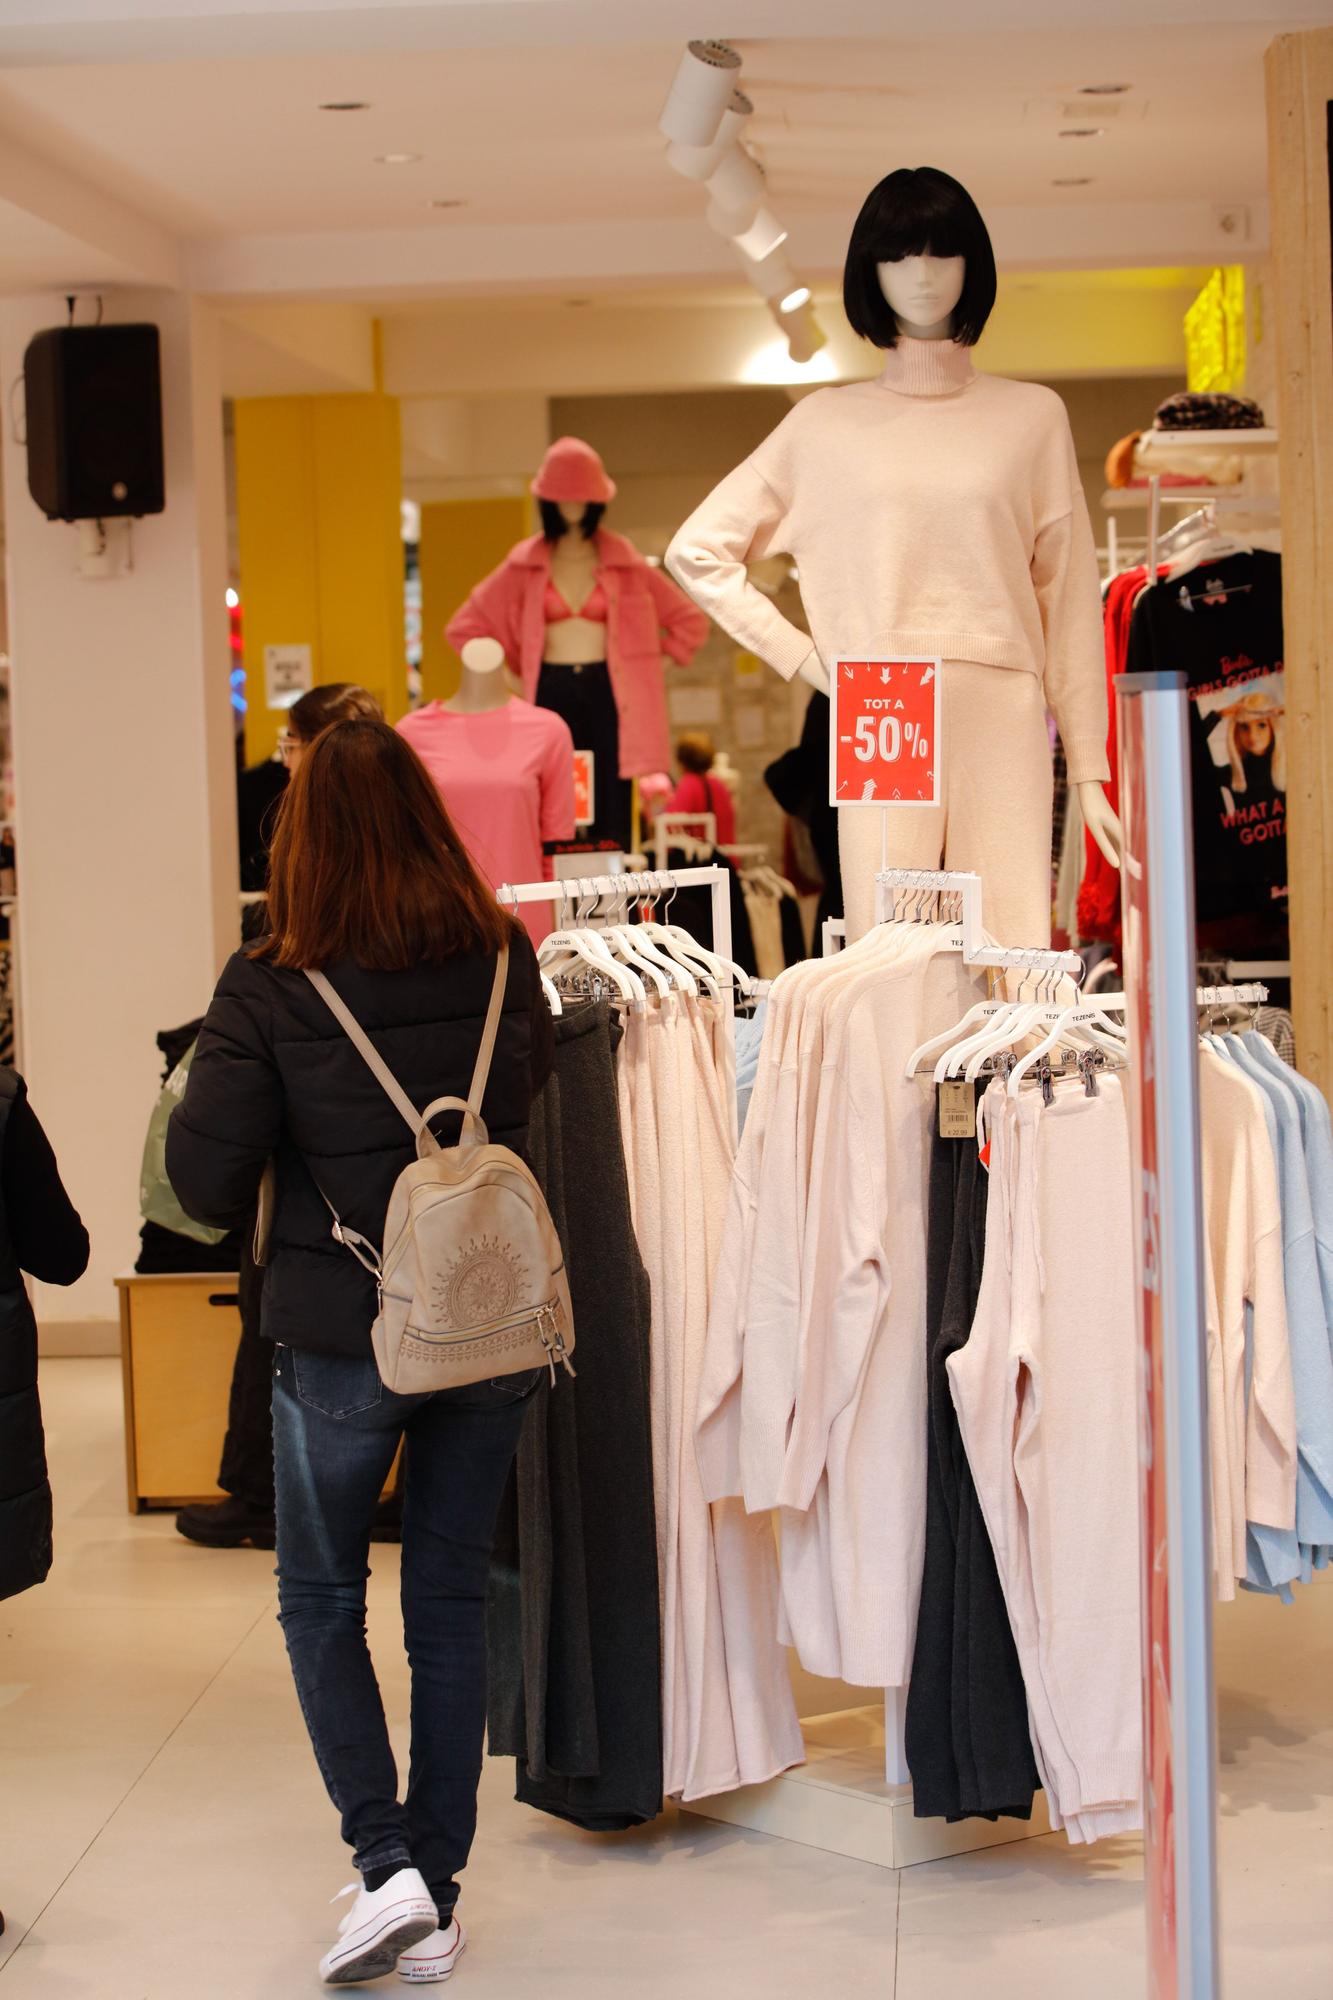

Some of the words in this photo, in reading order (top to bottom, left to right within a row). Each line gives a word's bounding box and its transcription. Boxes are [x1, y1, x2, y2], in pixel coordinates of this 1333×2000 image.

[1188, 679, 1222, 701] GIRLS
[1226, 665, 1269, 688] GOTTA
[864, 699, 891, 709] TOT
[894, 699, 904, 709] A
[840, 715, 928, 762] -50%
[1220, 801, 1267, 828] WHAT
[1272, 798, 1284, 816] A
[1072, 1012, 1096, 1021] TEZENIS
